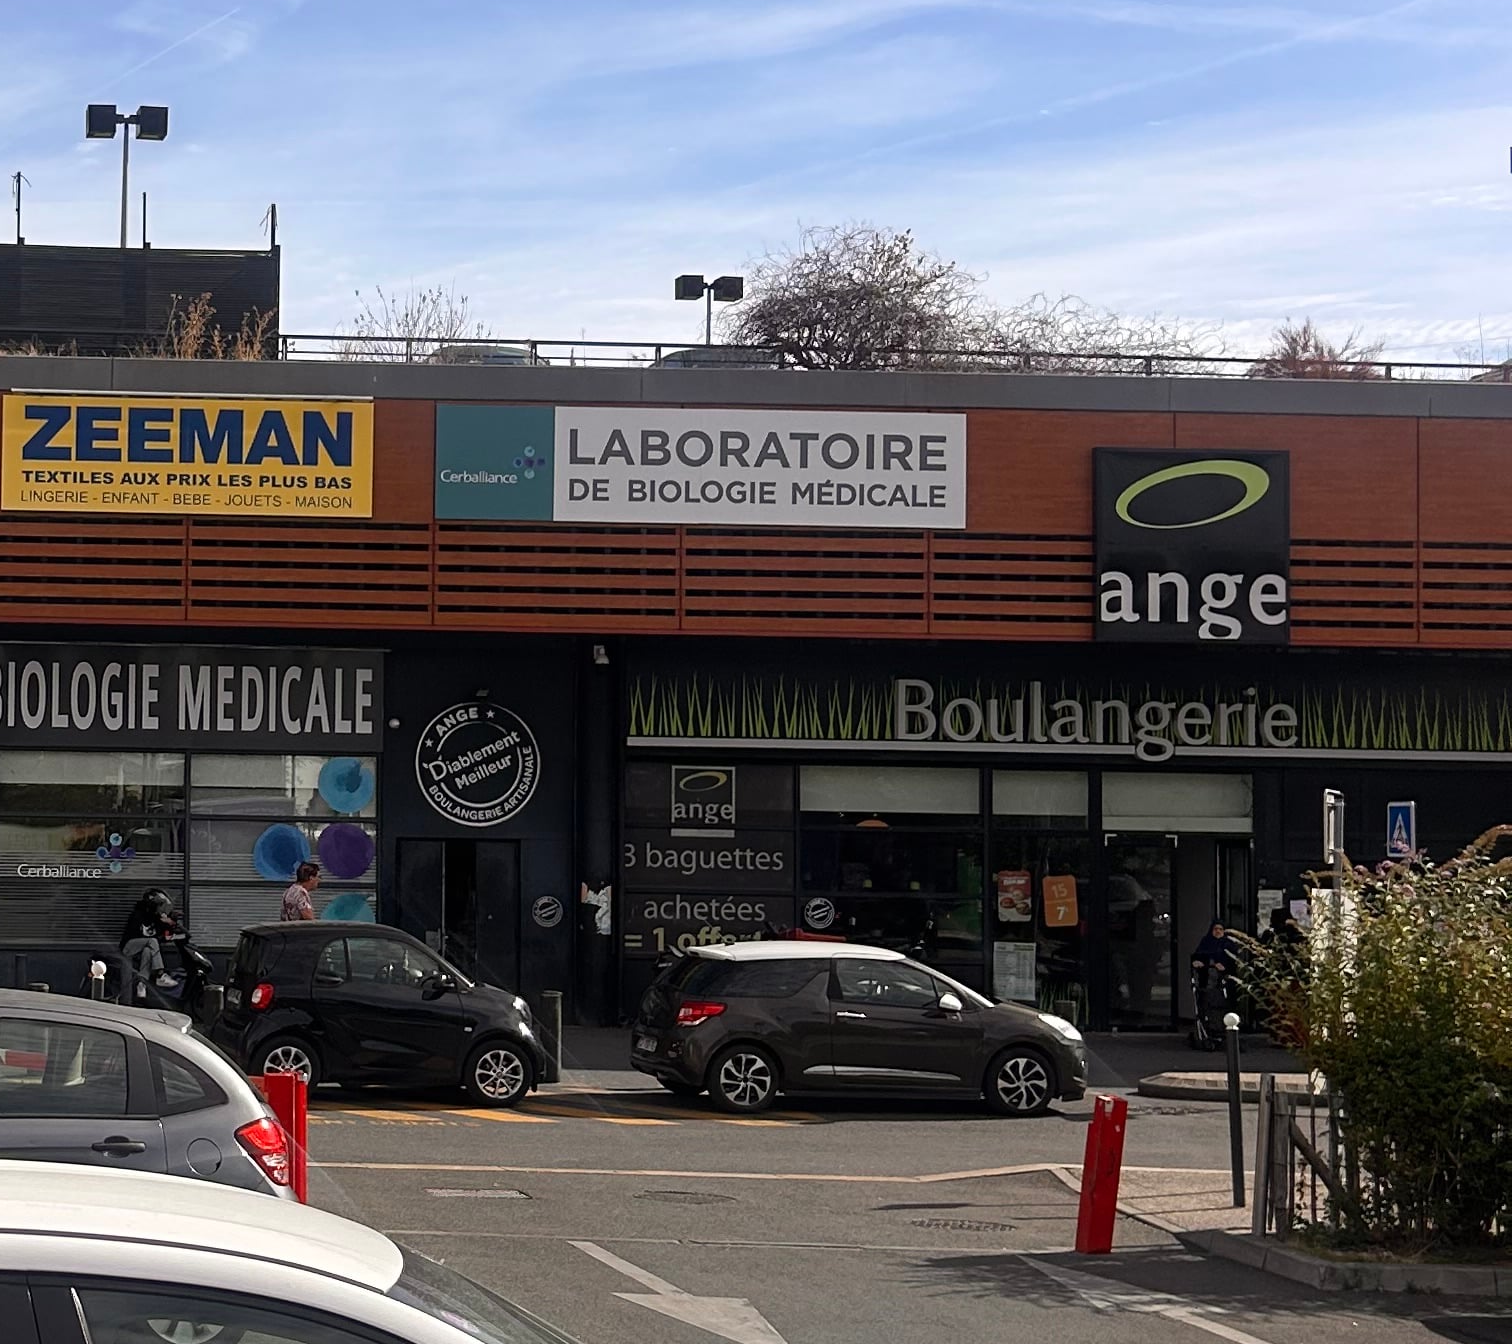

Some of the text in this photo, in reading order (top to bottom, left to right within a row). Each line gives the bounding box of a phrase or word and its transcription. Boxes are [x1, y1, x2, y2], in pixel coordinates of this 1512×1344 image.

[22, 405, 353, 467] ZEEMAN
[569, 428, 947, 472] LABORATOIRE
[22, 470, 352, 490] TEXTILES AUX PRIX LES PLUS BAS
[440, 470, 518, 484] Cerballiance
[20, 490, 88, 503] LINGERIE
[102, 491, 159, 505] ENFANT
[173, 493, 211, 505] BEBE
[224, 494, 282, 507] JOUETS
[295, 496, 352, 509] MAISON
[568, 478, 947, 508] DE BIOLOGIE MÉDICALE
[1099, 570, 1288, 640] ange
[178, 664, 373, 735] MEDICALE
[435, 707, 479, 737] ANGE
[895, 678, 1299, 762] Boulangerie
[428, 746, 534, 820] BOULANGERIE ARTISANALE
[454, 755, 512, 790] Meilleur
[674, 803, 734, 824] ange
[17, 864, 102, 879] Cerballiance
[624, 842, 784, 875] 3 baguettes
[1051, 883, 1068, 899] 15
[644, 894, 766, 921] achetées
[624, 934, 643, 947] =
[652, 927, 665, 952] 1
